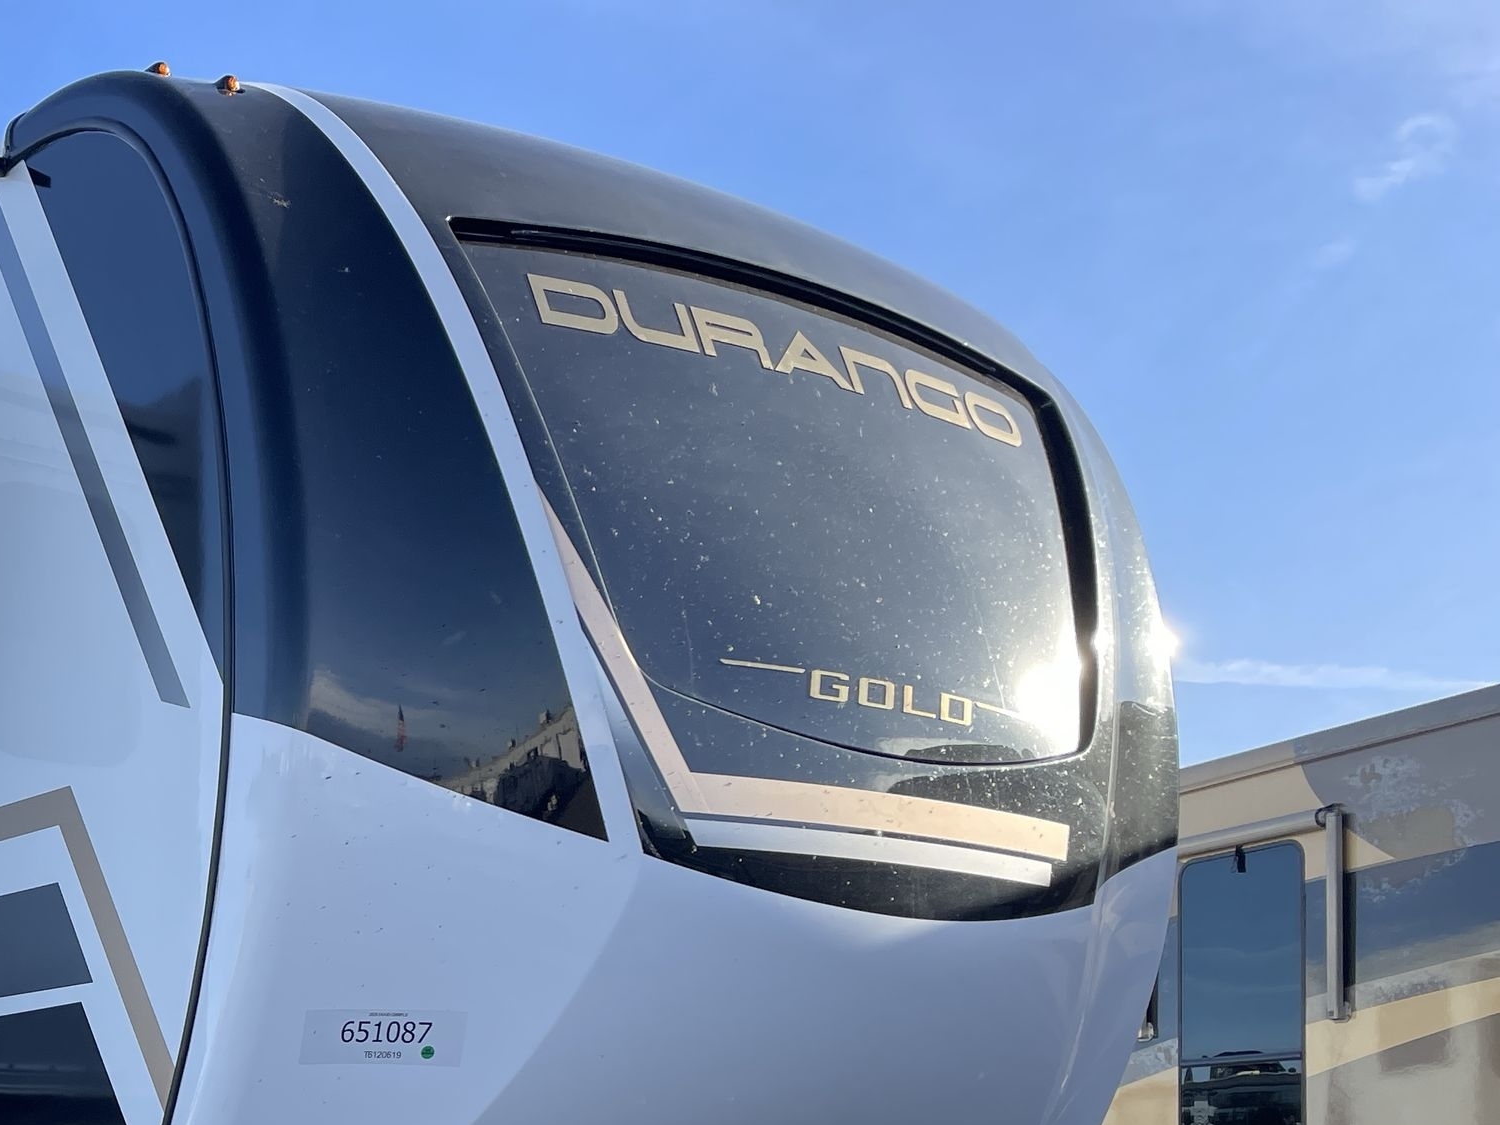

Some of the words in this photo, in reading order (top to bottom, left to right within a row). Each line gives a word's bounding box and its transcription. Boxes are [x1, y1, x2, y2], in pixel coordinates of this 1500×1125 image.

[526, 272, 1023, 448] DURANGO
[809, 669, 973, 726] GOLD
[341, 1020, 433, 1044] 651087
